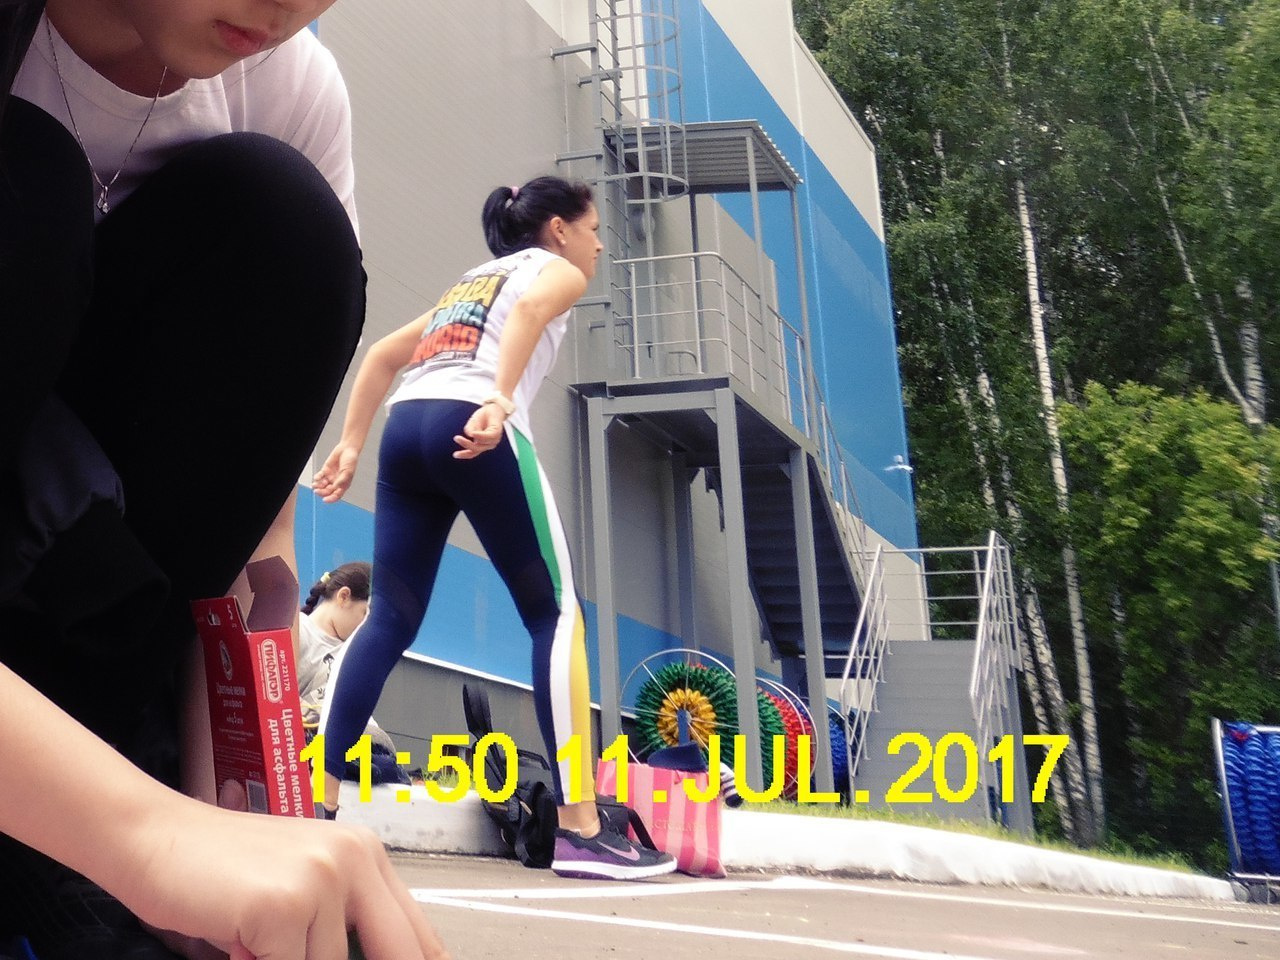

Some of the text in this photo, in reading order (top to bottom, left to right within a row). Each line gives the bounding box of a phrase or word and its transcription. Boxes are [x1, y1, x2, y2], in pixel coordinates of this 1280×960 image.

[264, 643, 279, 698] ПИФАГОР
[281, 664, 291, 691] 221170
[267, 718, 289, 813] для асфальта
[281, 708, 298, 772] Цветные
